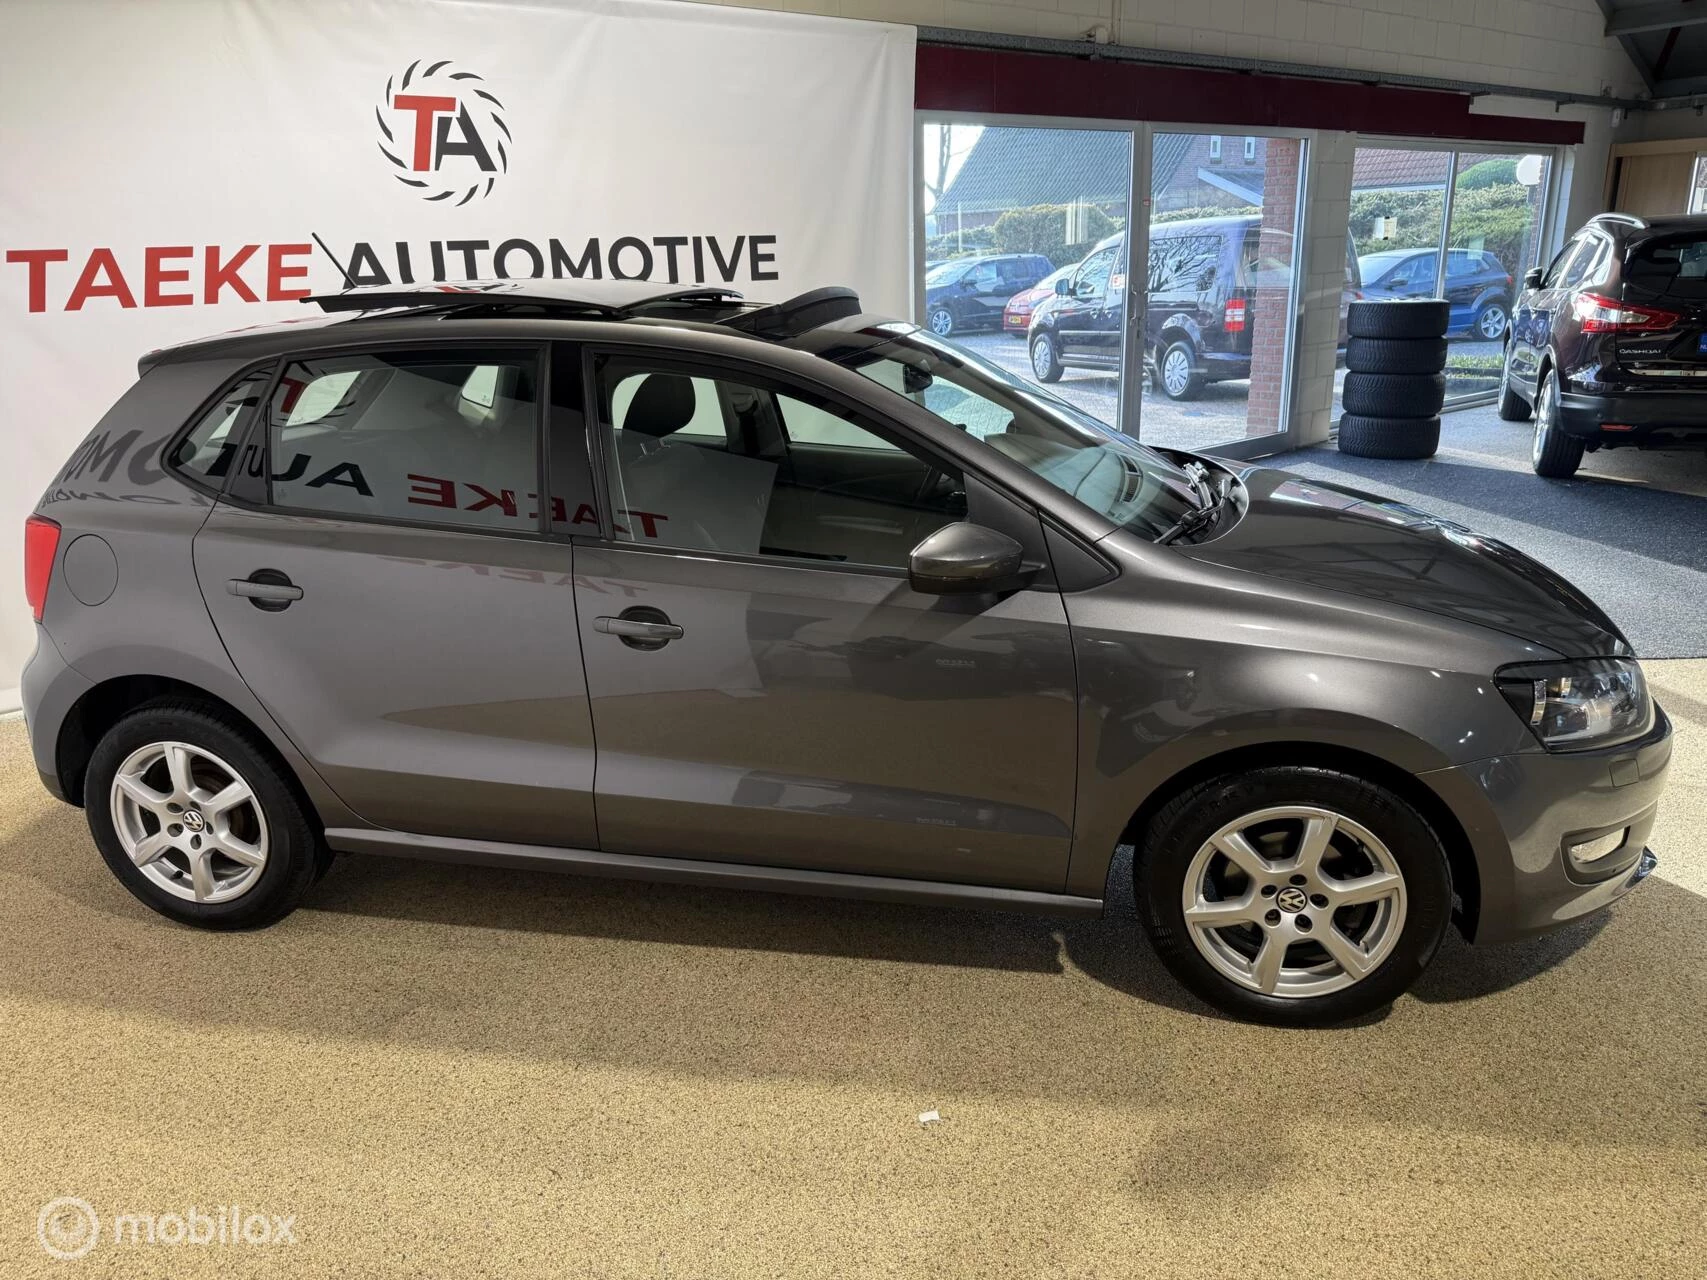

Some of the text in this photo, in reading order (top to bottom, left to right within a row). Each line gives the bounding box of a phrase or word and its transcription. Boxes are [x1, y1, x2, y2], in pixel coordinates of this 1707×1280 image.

[394, 95, 498, 171] TA
[6, 235, 779, 313] TAEKE AUTOMOTIVE
